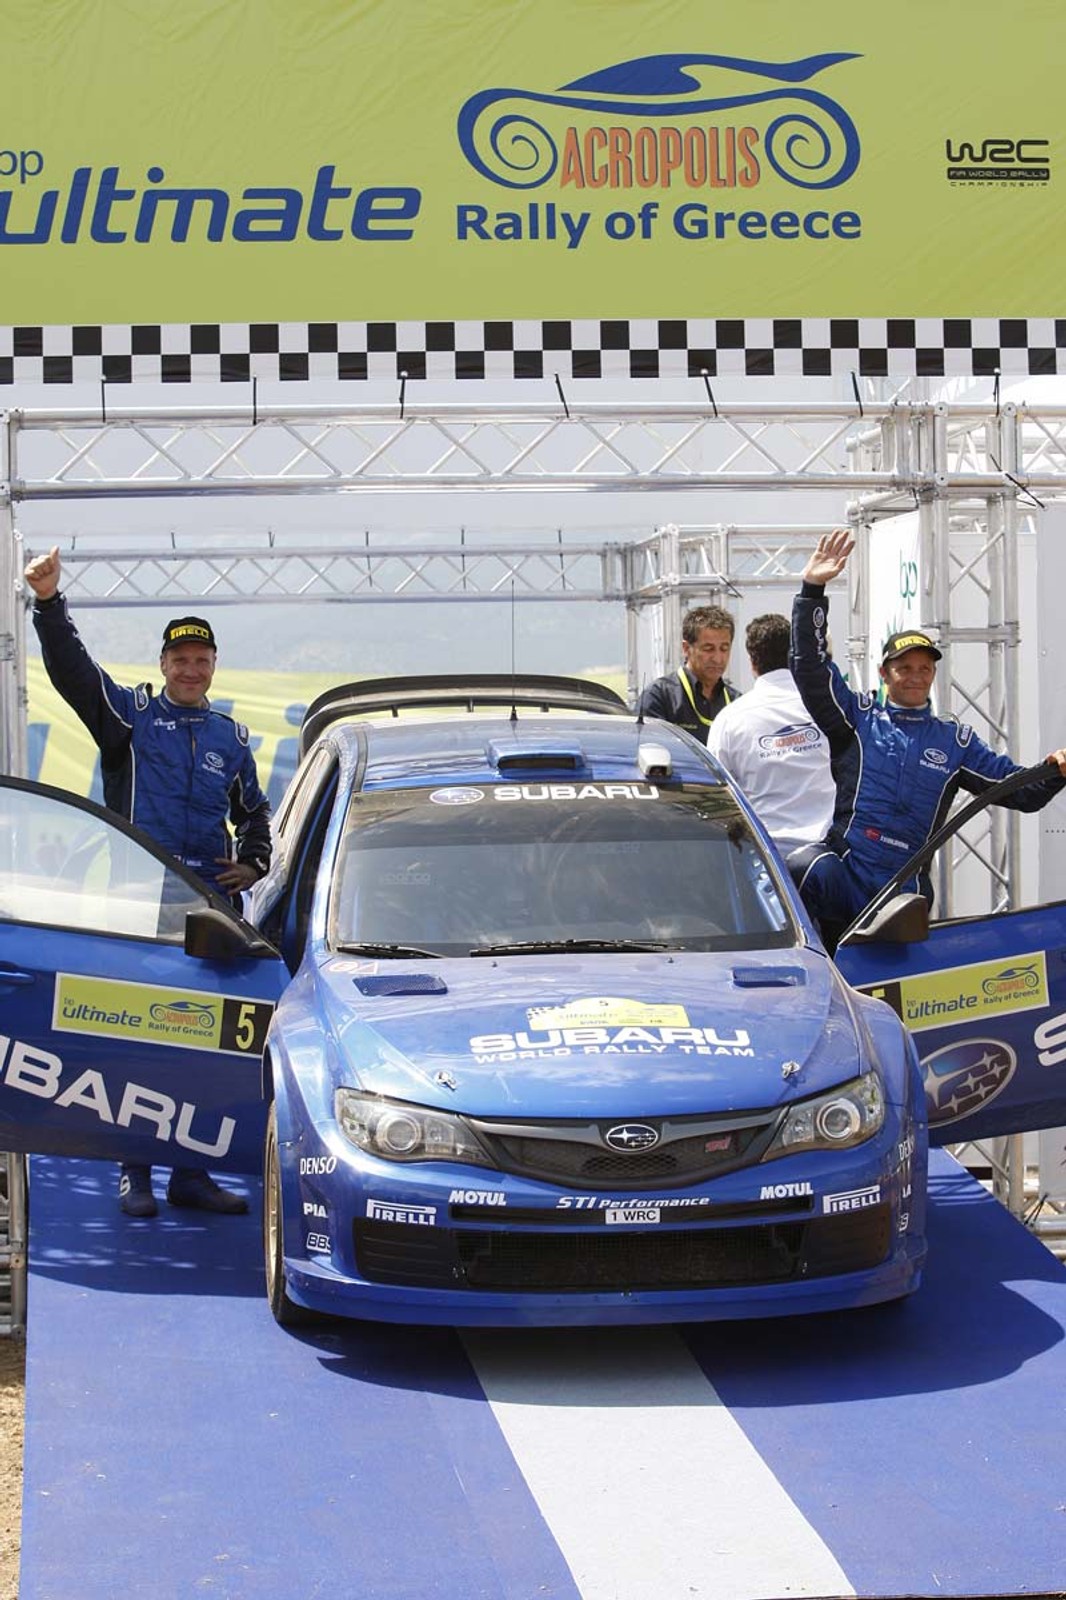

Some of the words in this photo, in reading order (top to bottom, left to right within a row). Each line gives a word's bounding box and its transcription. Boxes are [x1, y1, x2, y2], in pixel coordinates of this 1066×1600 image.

[560, 127, 761, 189] ACROPOLIS
[946, 139, 1049, 163] WRC
[949, 170, 966, 178] FIA
[968, 170, 1008, 178] WORLD
[1010, 170, 1048, 178] RALLY
[0, 165, 422, 245] ultimate
[457, 203, 590, 248] Rally
[604, 203, 659, 240] of
[673, 204, 862, 240] Greece
[494, 785, 660, 800] SUBARU
[63, 1004, 143, 1027] ultimate
[907, 994, 978, 1019] ultimate
[148, 1022, 171, 1033] Rally
[183, 1027, 214, 1038] Greece
[236, 1003, 256, 1050] 5
[470, 1026, 751, 1054] SUBARU
[474, 1046, 572, 1065] WORLD
[583, 1044, 667, 1056] RALLY
[680, 1045, 755, 1058] TEAM
[0, 1035, 236, 1158] BARU
[300, 1156, 337, 1175] DENSO
[449, 1189, 507, 1207] MOTUL
[556, 1196, 596, 1209] STI
[599, 1197, 710, 1209] Performance
[760, 1182, 813, 1200] MOTUL
[823, 1185, 880, 1214] PIRELLI
[366, 1199, 437, 1226] PIRELLI
[611, 1211, 618, 1221] 1
[623, 1211, 658, 1222] WRC
